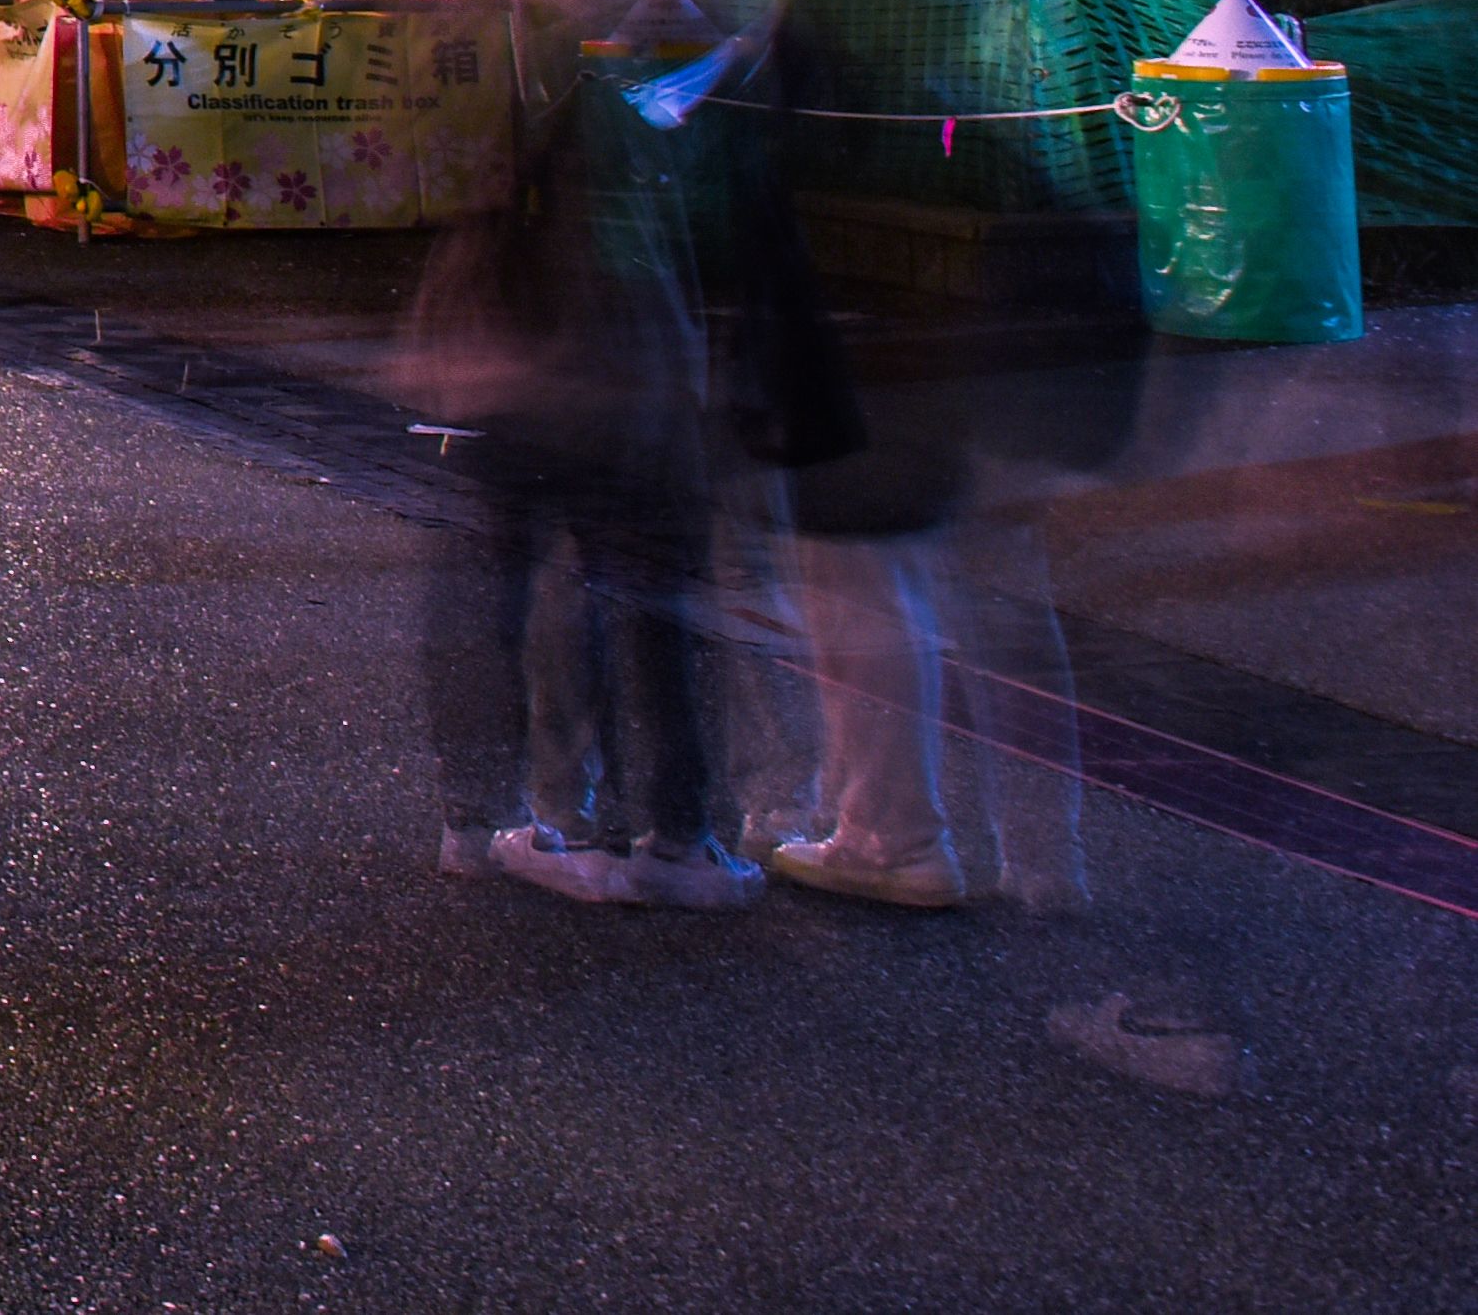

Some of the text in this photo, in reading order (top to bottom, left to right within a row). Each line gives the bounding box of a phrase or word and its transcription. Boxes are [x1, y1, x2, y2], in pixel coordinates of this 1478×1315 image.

[143, 38, 479, 87] 分別ゴミ箱
[187, 93, 440, 111] Classification trash box
